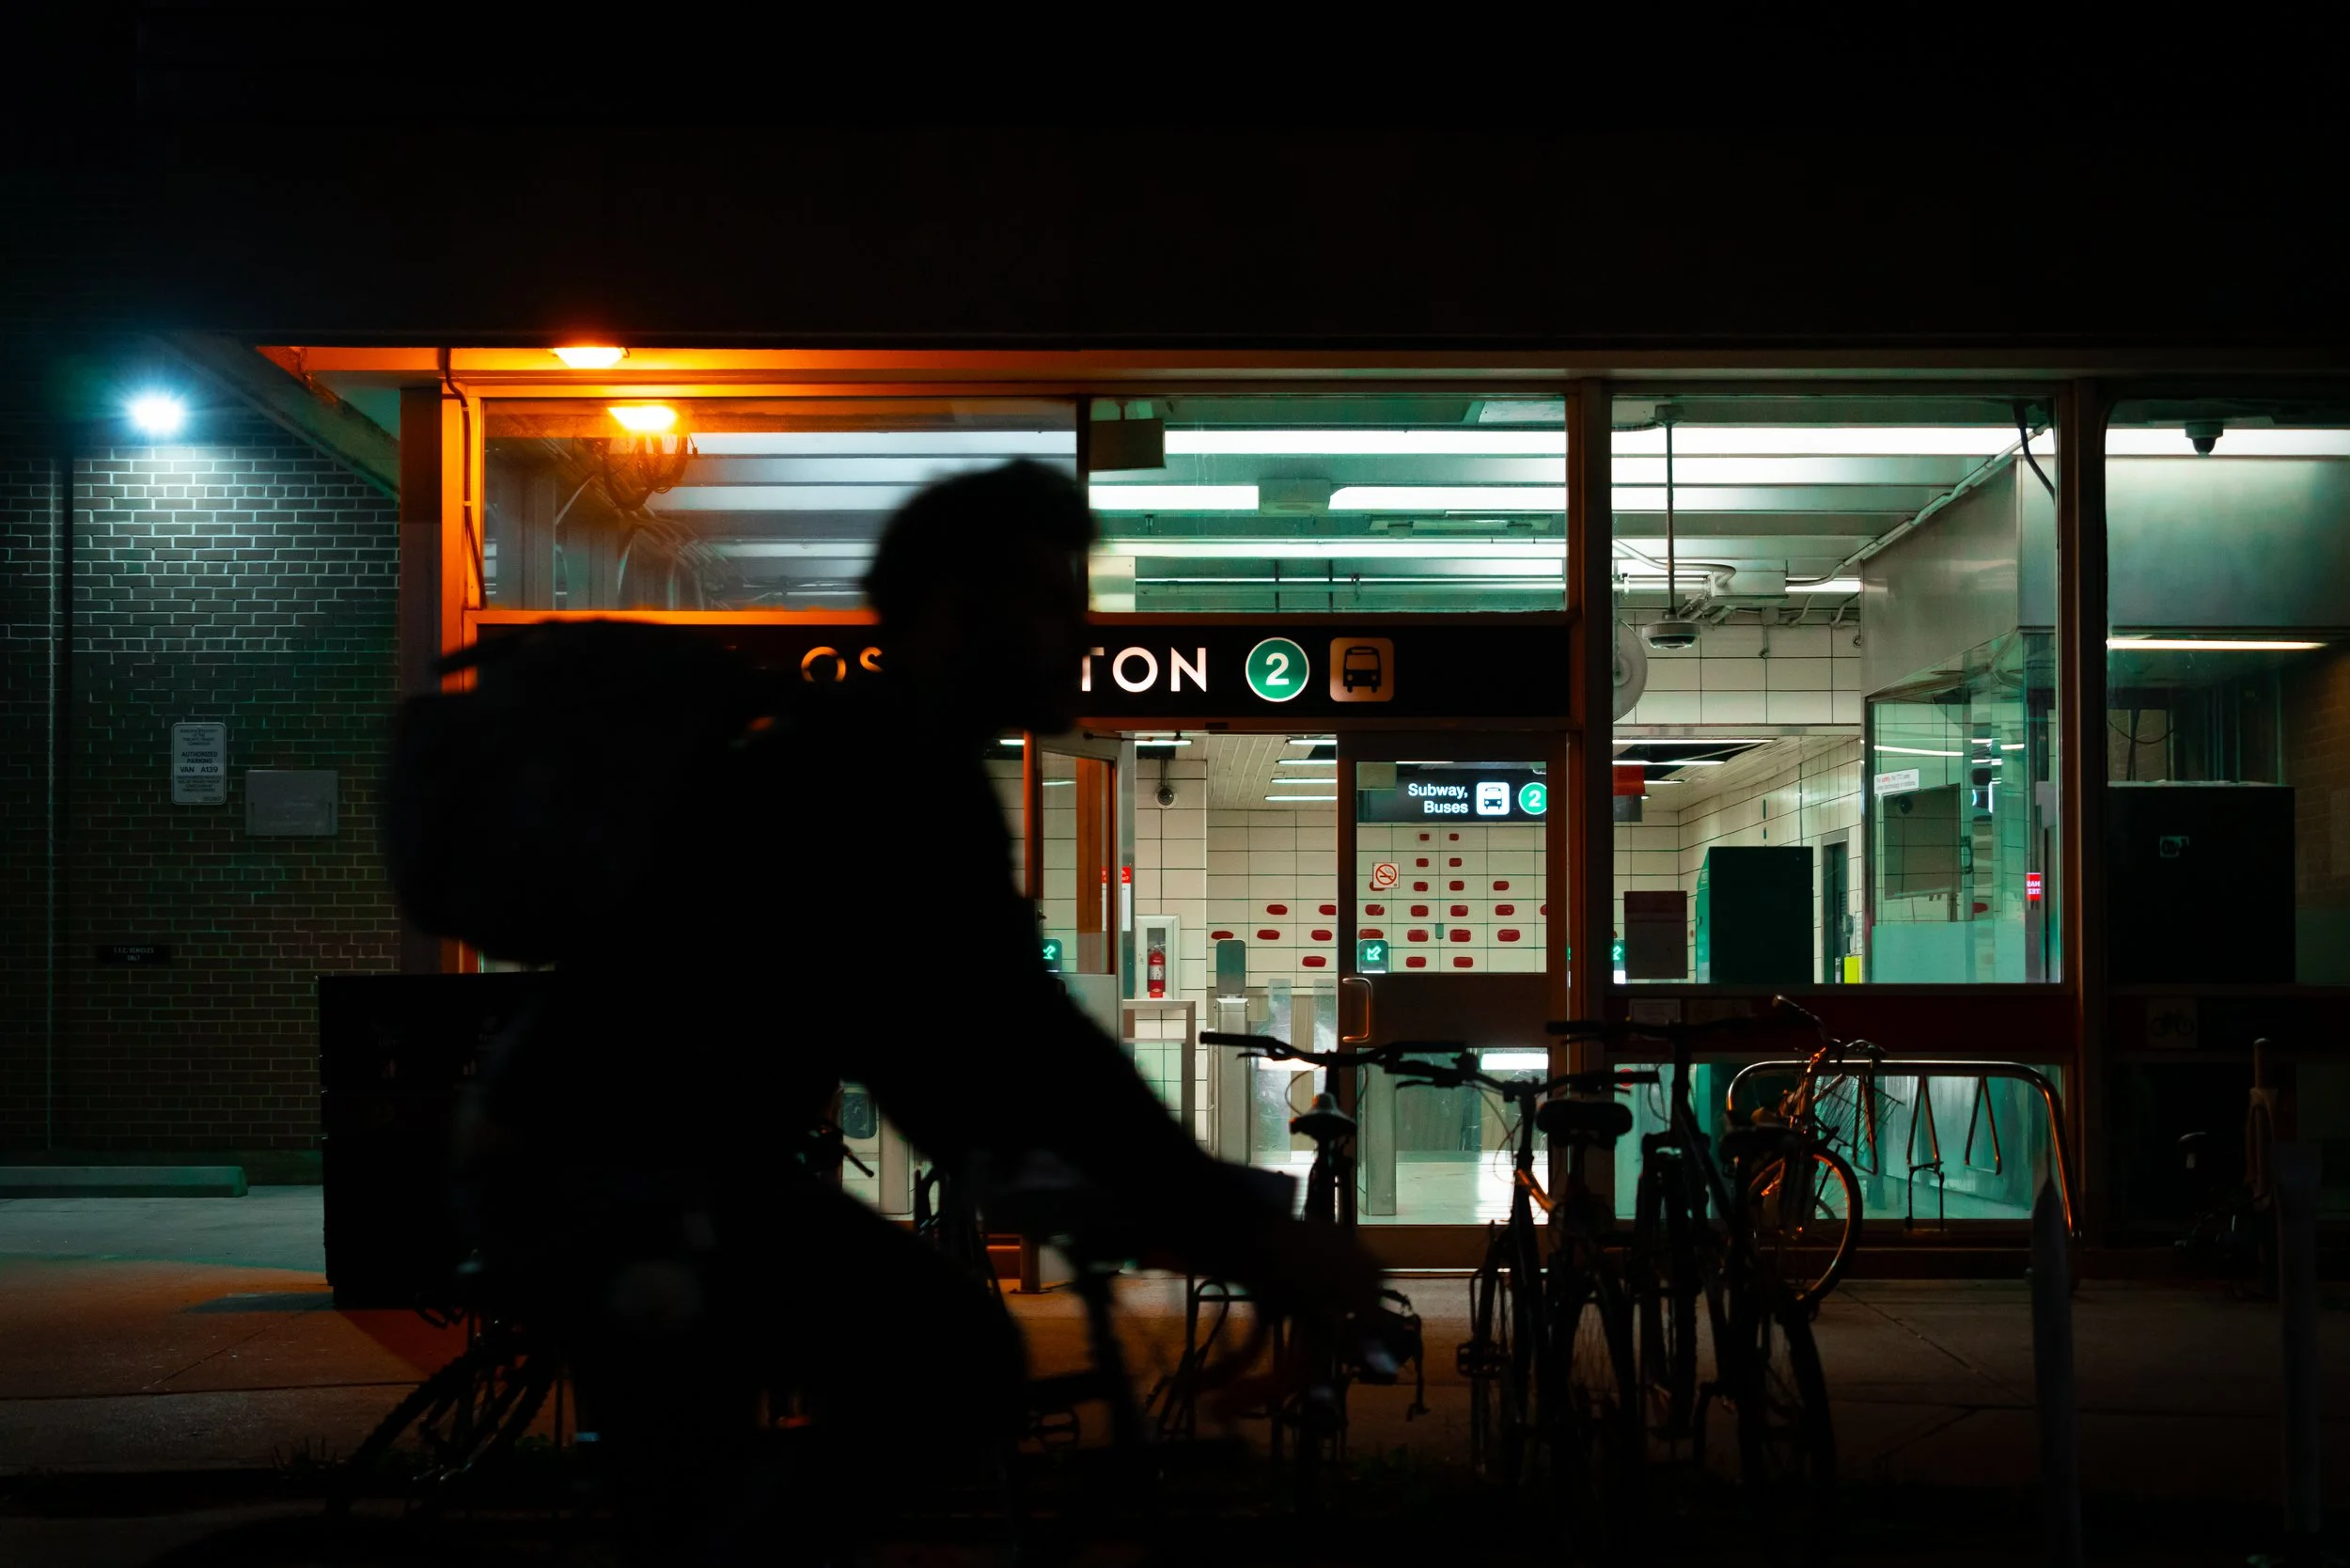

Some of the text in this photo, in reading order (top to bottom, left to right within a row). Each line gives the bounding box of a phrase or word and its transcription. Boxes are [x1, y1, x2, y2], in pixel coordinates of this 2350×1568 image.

[1265, 652, 1290, 685] 2
[1408, 783, 1468, 799] Subway,
[1528, 790, 1542, 808] 2
[1423, 801, 1468, 813] Buses
